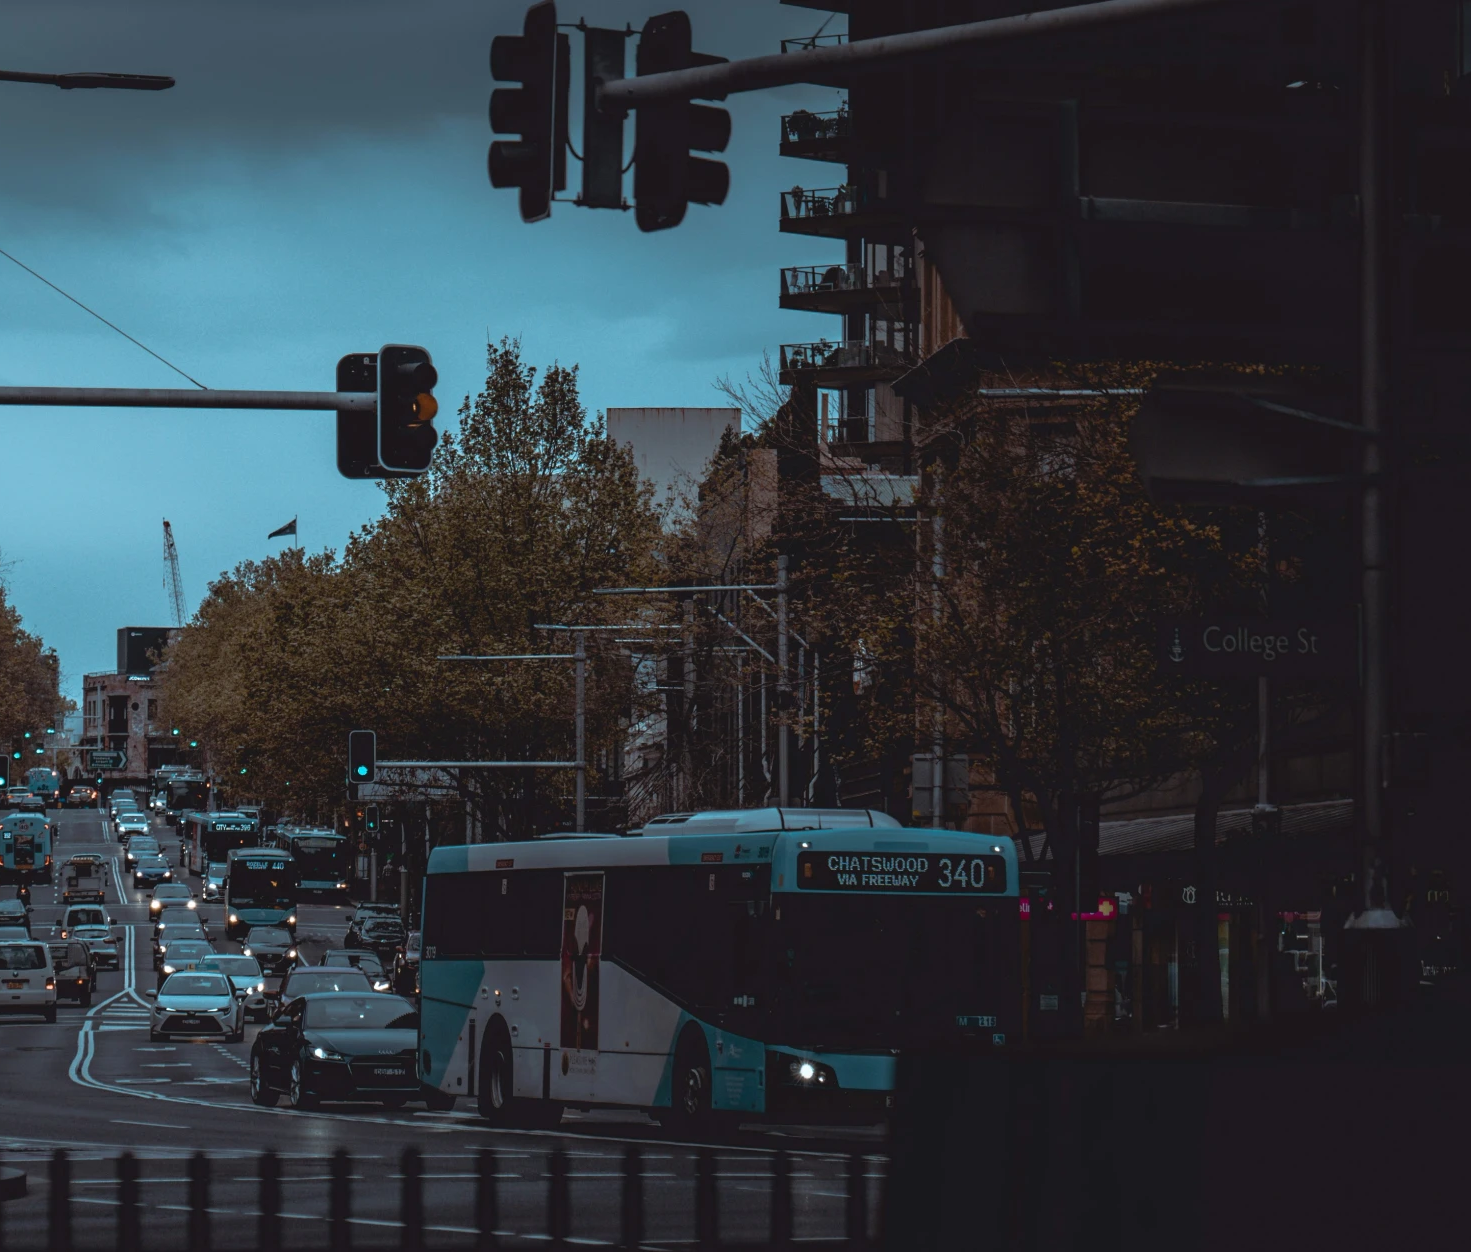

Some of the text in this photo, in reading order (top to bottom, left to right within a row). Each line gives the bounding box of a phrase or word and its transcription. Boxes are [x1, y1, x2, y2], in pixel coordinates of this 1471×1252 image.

[1203, 626, 1319, 661] College St
[272, 861, 285, 870] 440
[828, 856, 984, 888] CHATSWOOD 340
[837, 873, 919, 887] VIA FREEWAY
